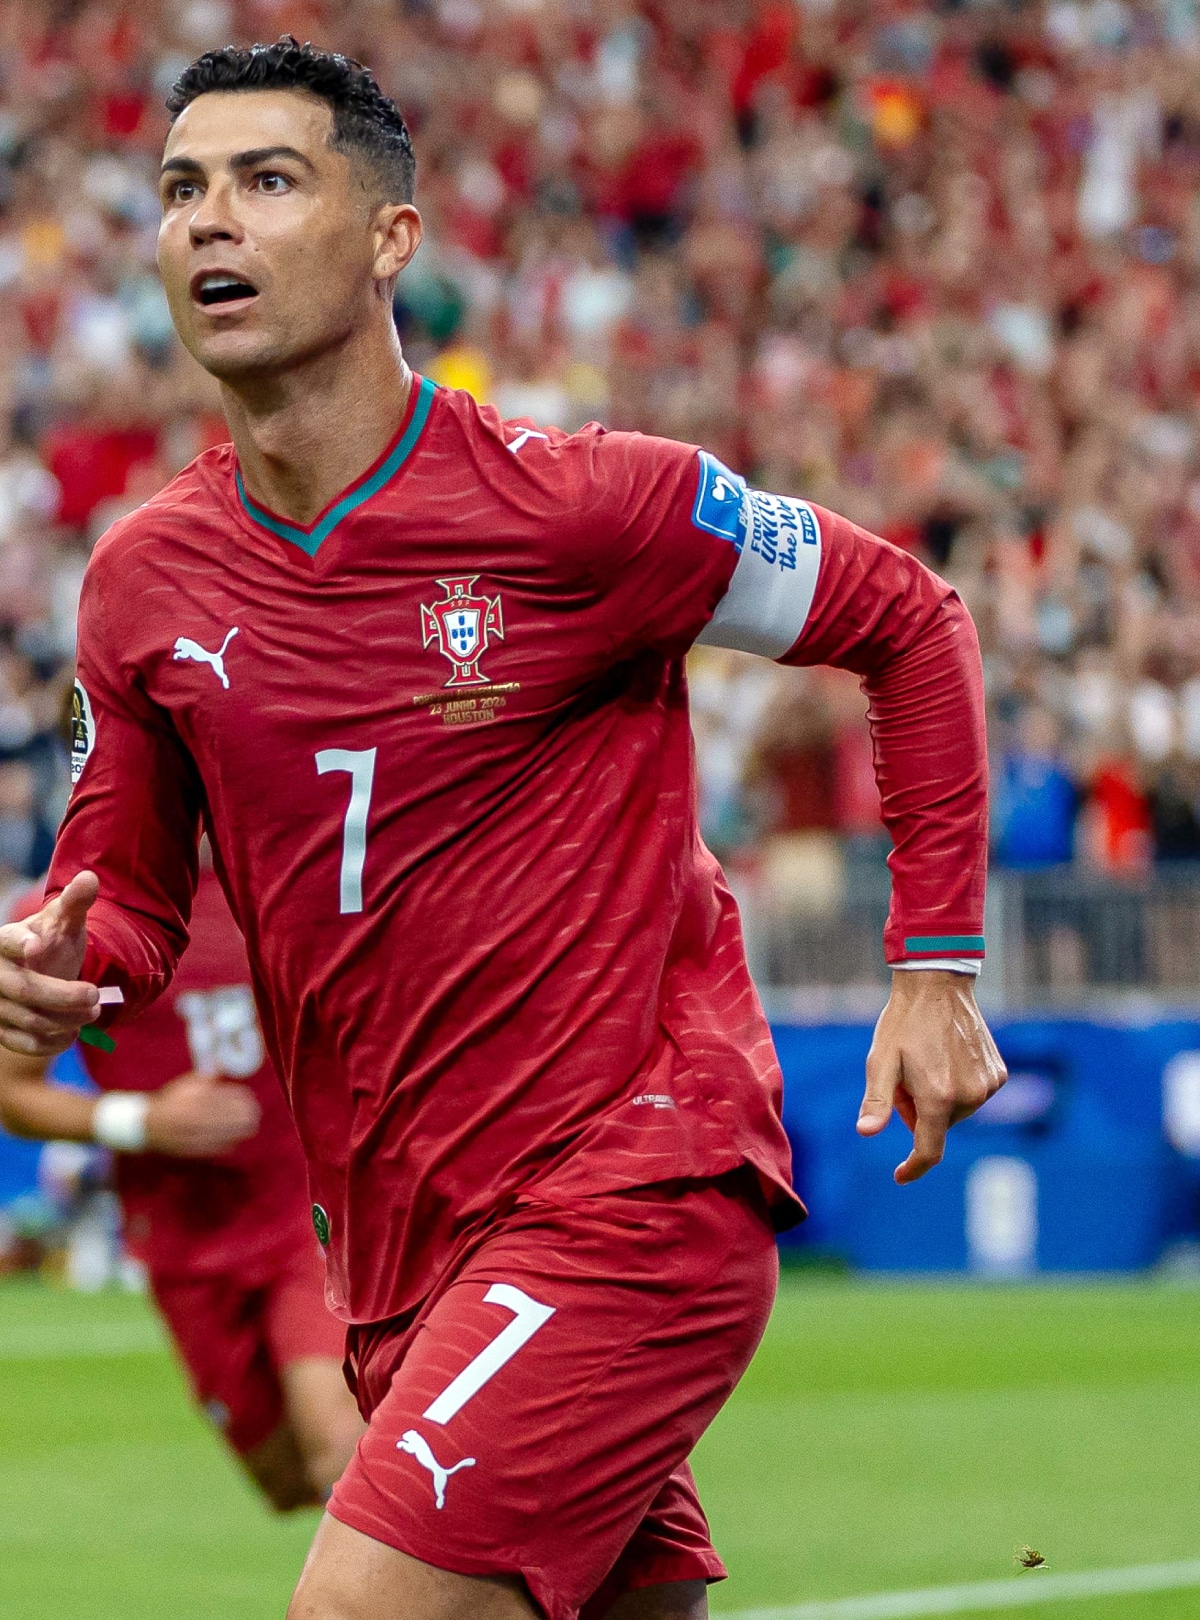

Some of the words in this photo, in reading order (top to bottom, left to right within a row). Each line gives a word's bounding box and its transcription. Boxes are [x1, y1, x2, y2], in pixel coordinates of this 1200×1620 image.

[800, 508, 815, 541] FIFA
[779, 533, 797, 572] the
[429, 704, 442, 715] 23
[445, 699, 477, 713] JUNHO
[481, 697, 507, 709] 2026
[443, 709, 494, 724] HOUSTON
[315, 747, 377, 914] 7
[422, 1282, 557, 1425] 7
